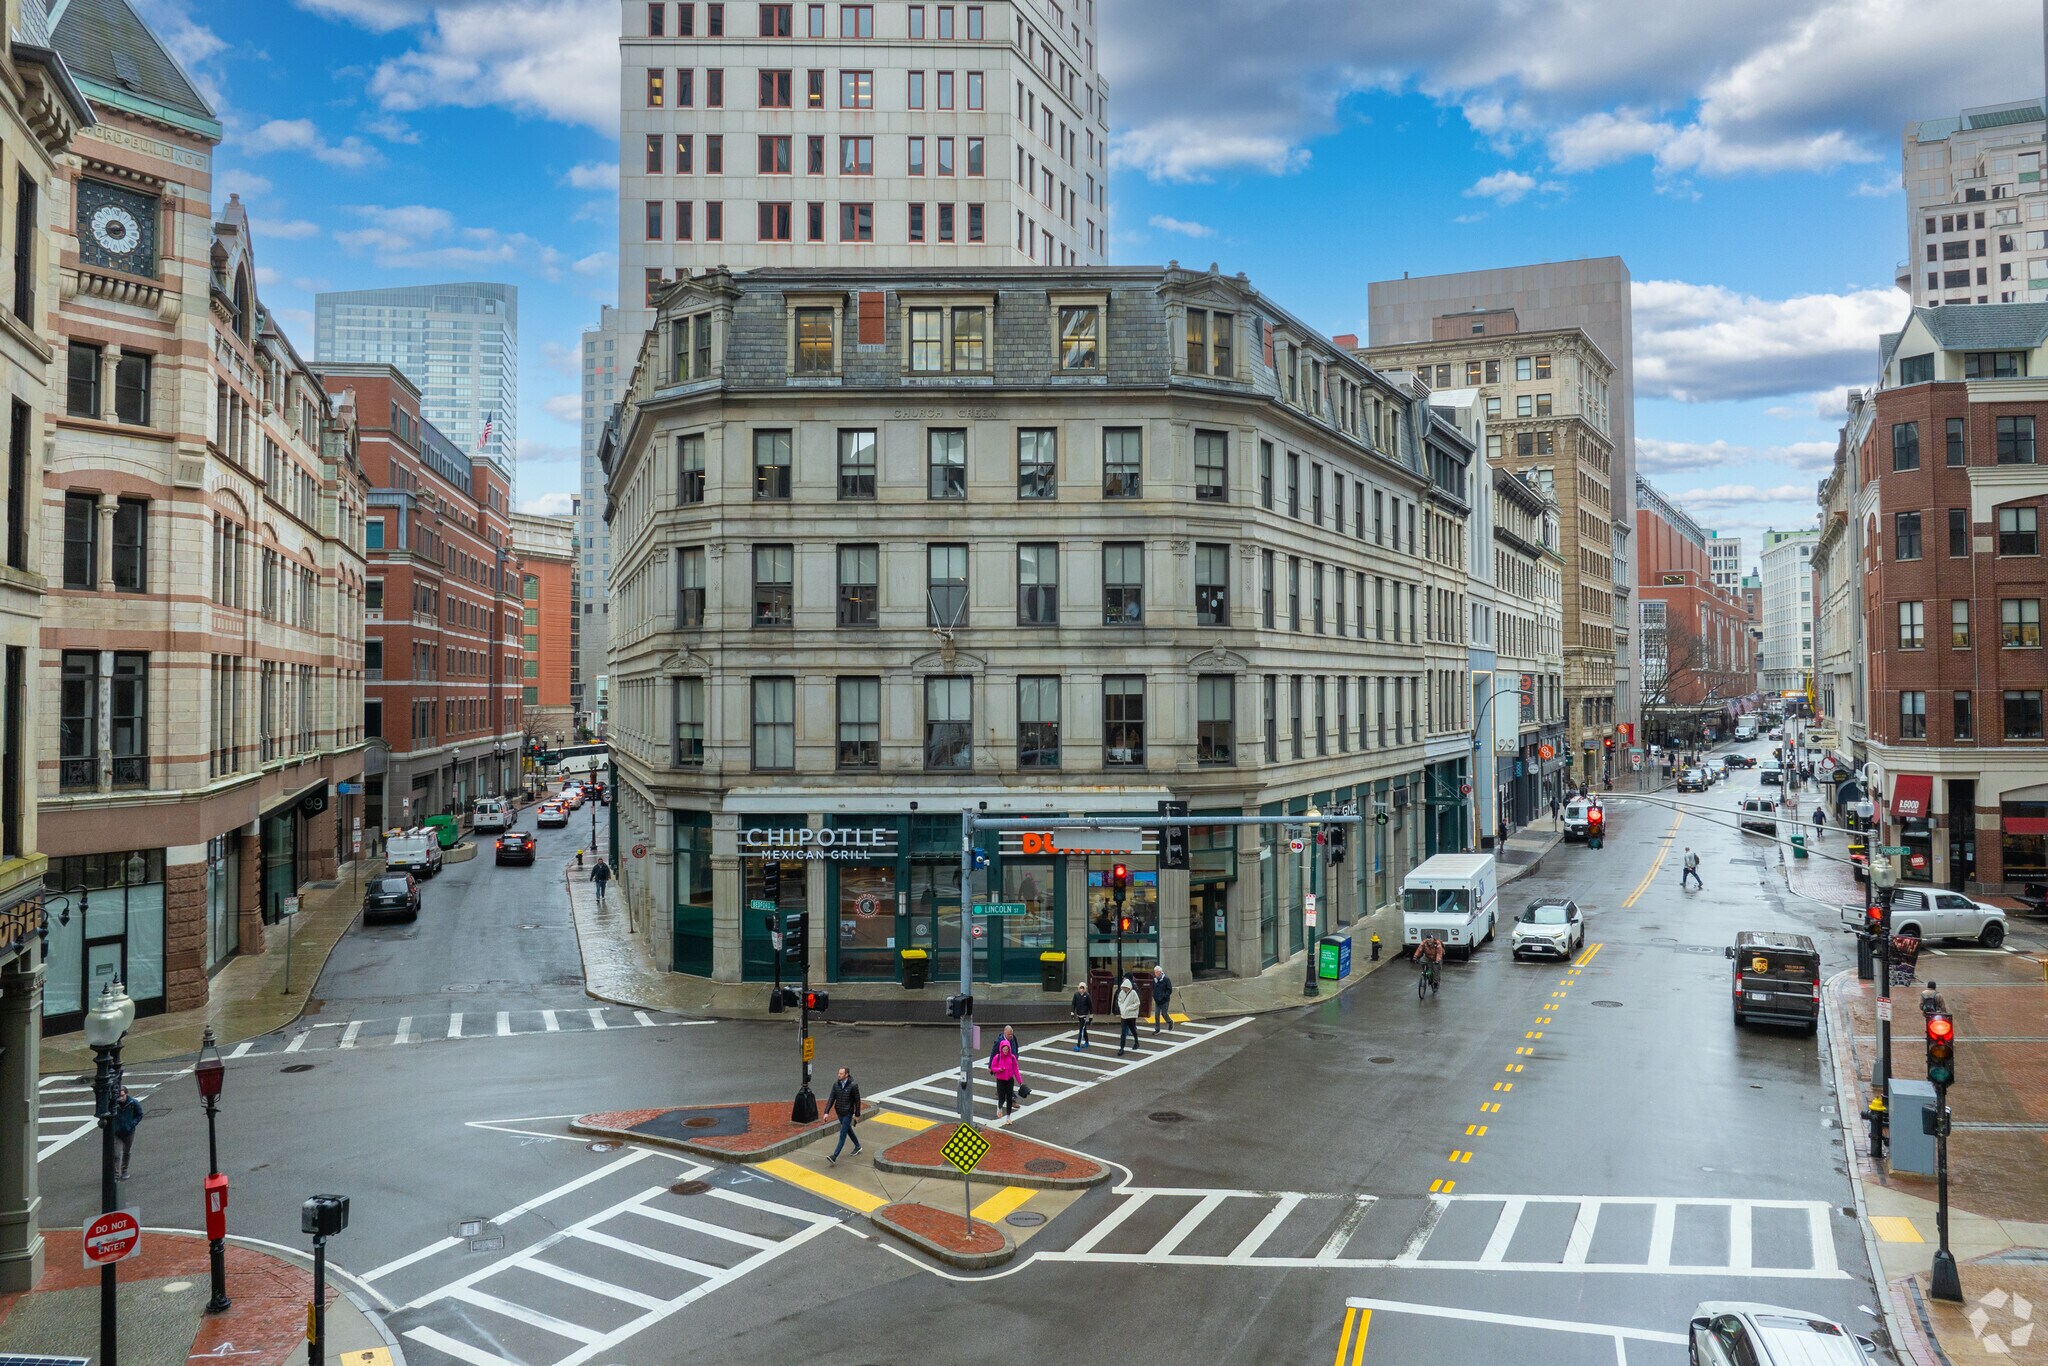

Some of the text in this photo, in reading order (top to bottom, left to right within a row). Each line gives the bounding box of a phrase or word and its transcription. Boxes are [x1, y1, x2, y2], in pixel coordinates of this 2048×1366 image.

[893, 408, 997, 418] CHURCH GREEN
[1498, 738, 1515, 750] 99
[304, 797, 323, 810] 99
[1342, 804, 1357, 816] GNC
[746, 828, 886, 847] CHIPOTLE
[761, 850, 871, 860] MEXICAN GRILL
[855, 893, 880, 905] CHIPOTLE
[984, 905, 1012, 913] LINCOLN
[96, 1219, 127, 1234] DO NOT
[98, 1241, 125, 1254] ENTER
